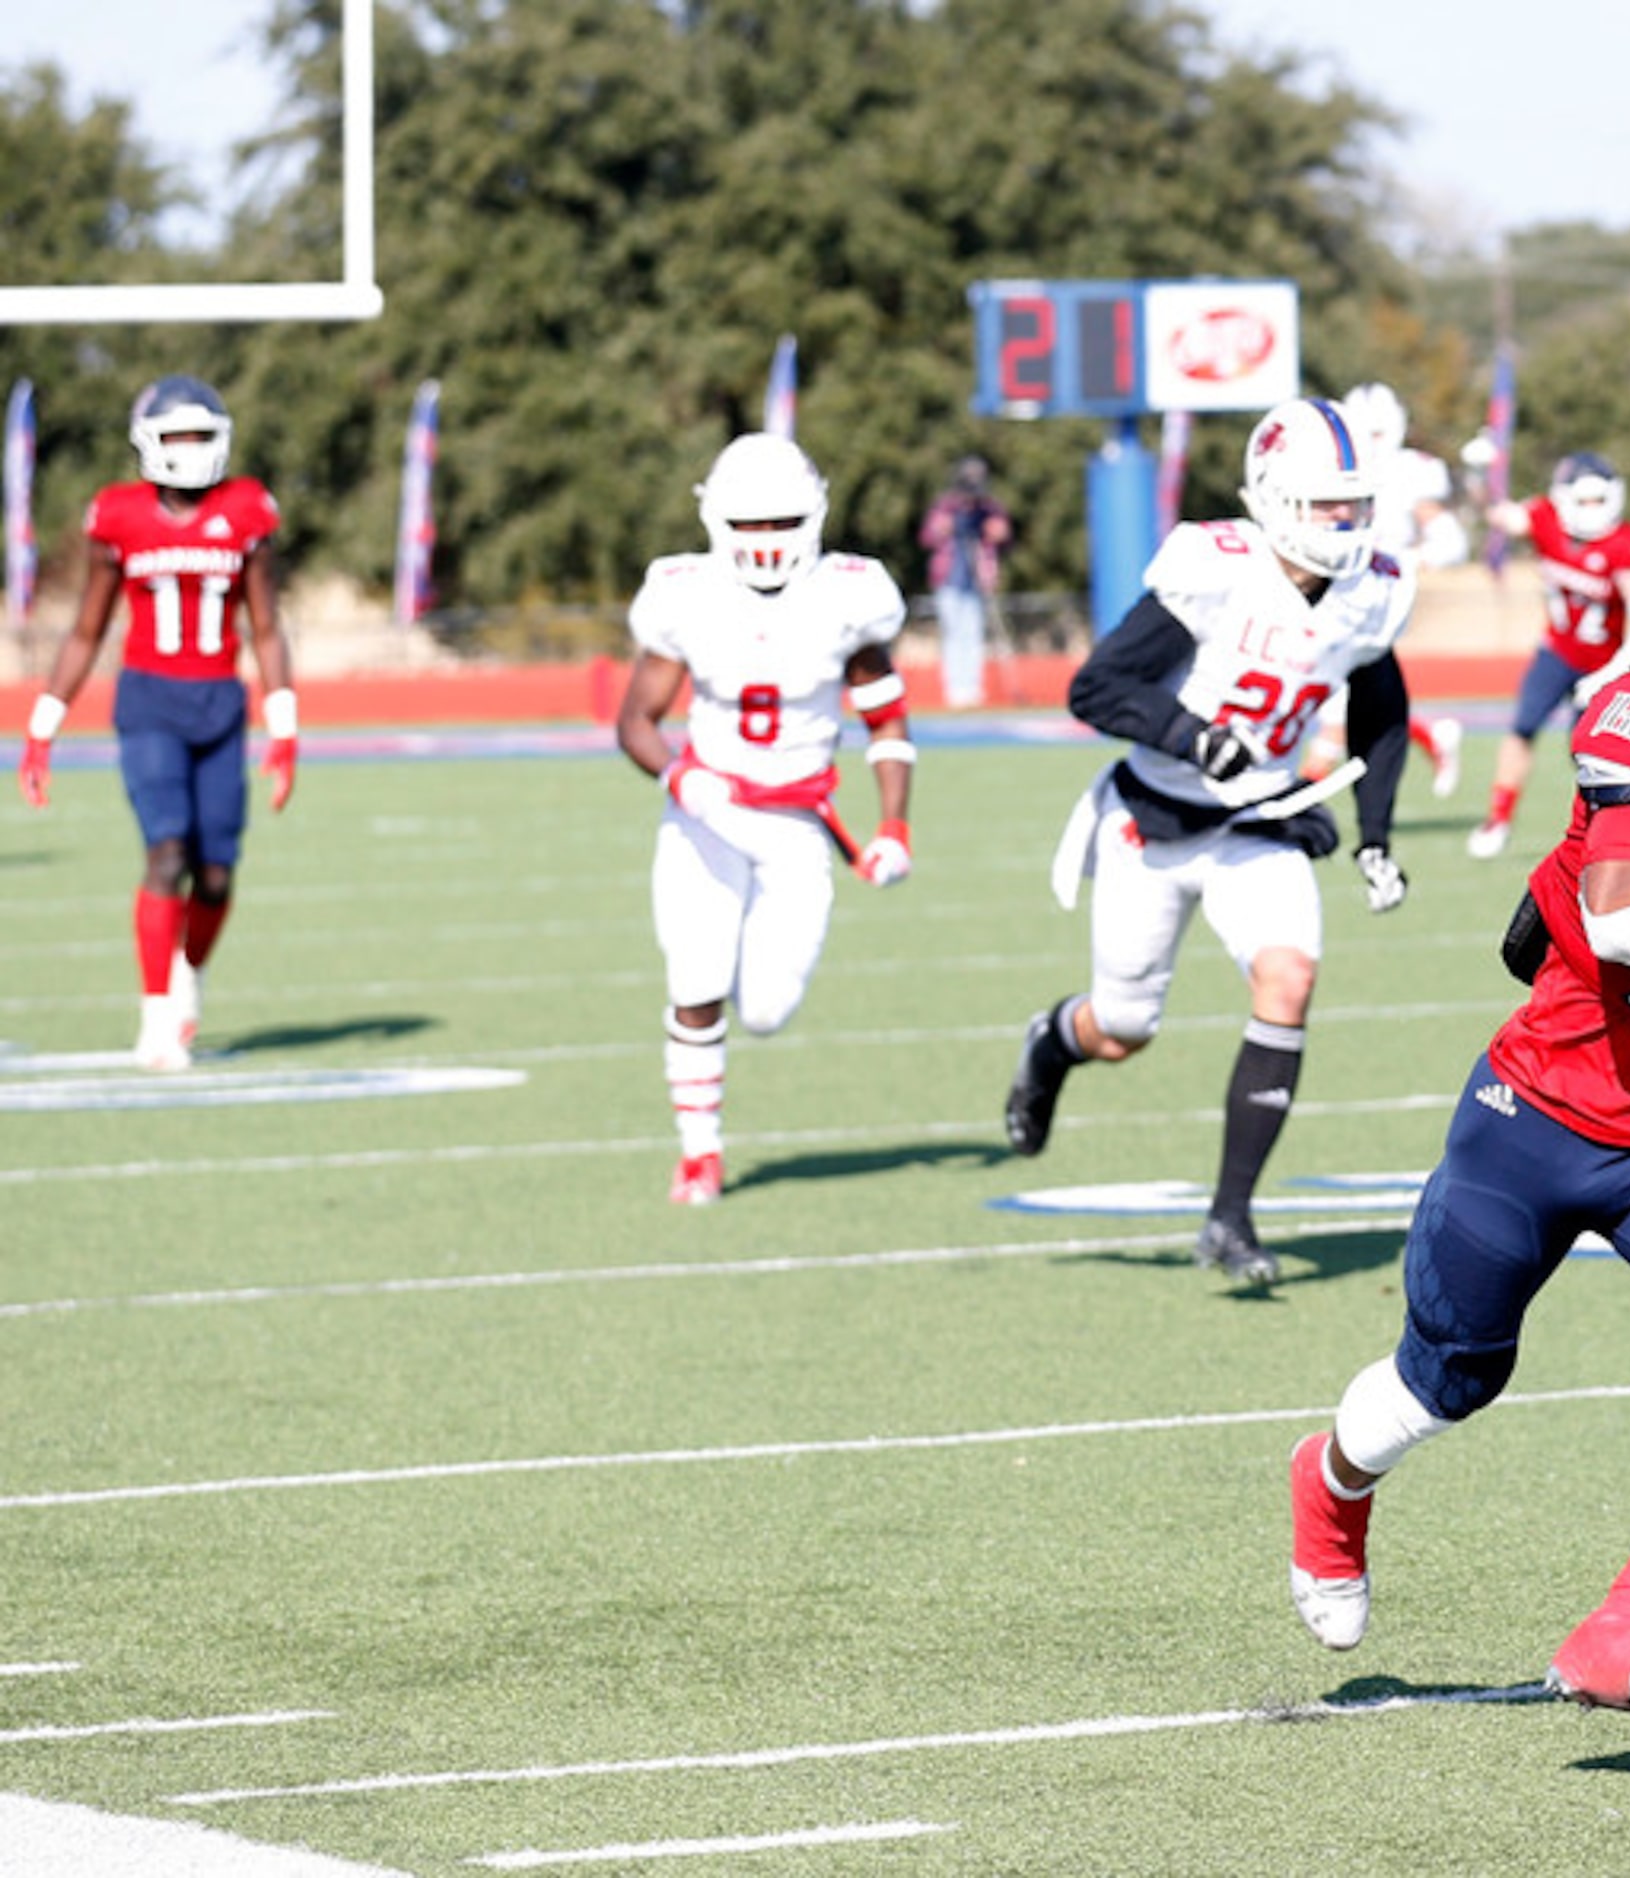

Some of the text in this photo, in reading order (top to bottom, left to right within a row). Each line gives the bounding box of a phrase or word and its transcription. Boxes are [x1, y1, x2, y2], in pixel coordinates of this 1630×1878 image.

[148, 575, 233, 657] 11
[738, 683, 782, 747] 8
[1212, 669, 1332, 758] 20
